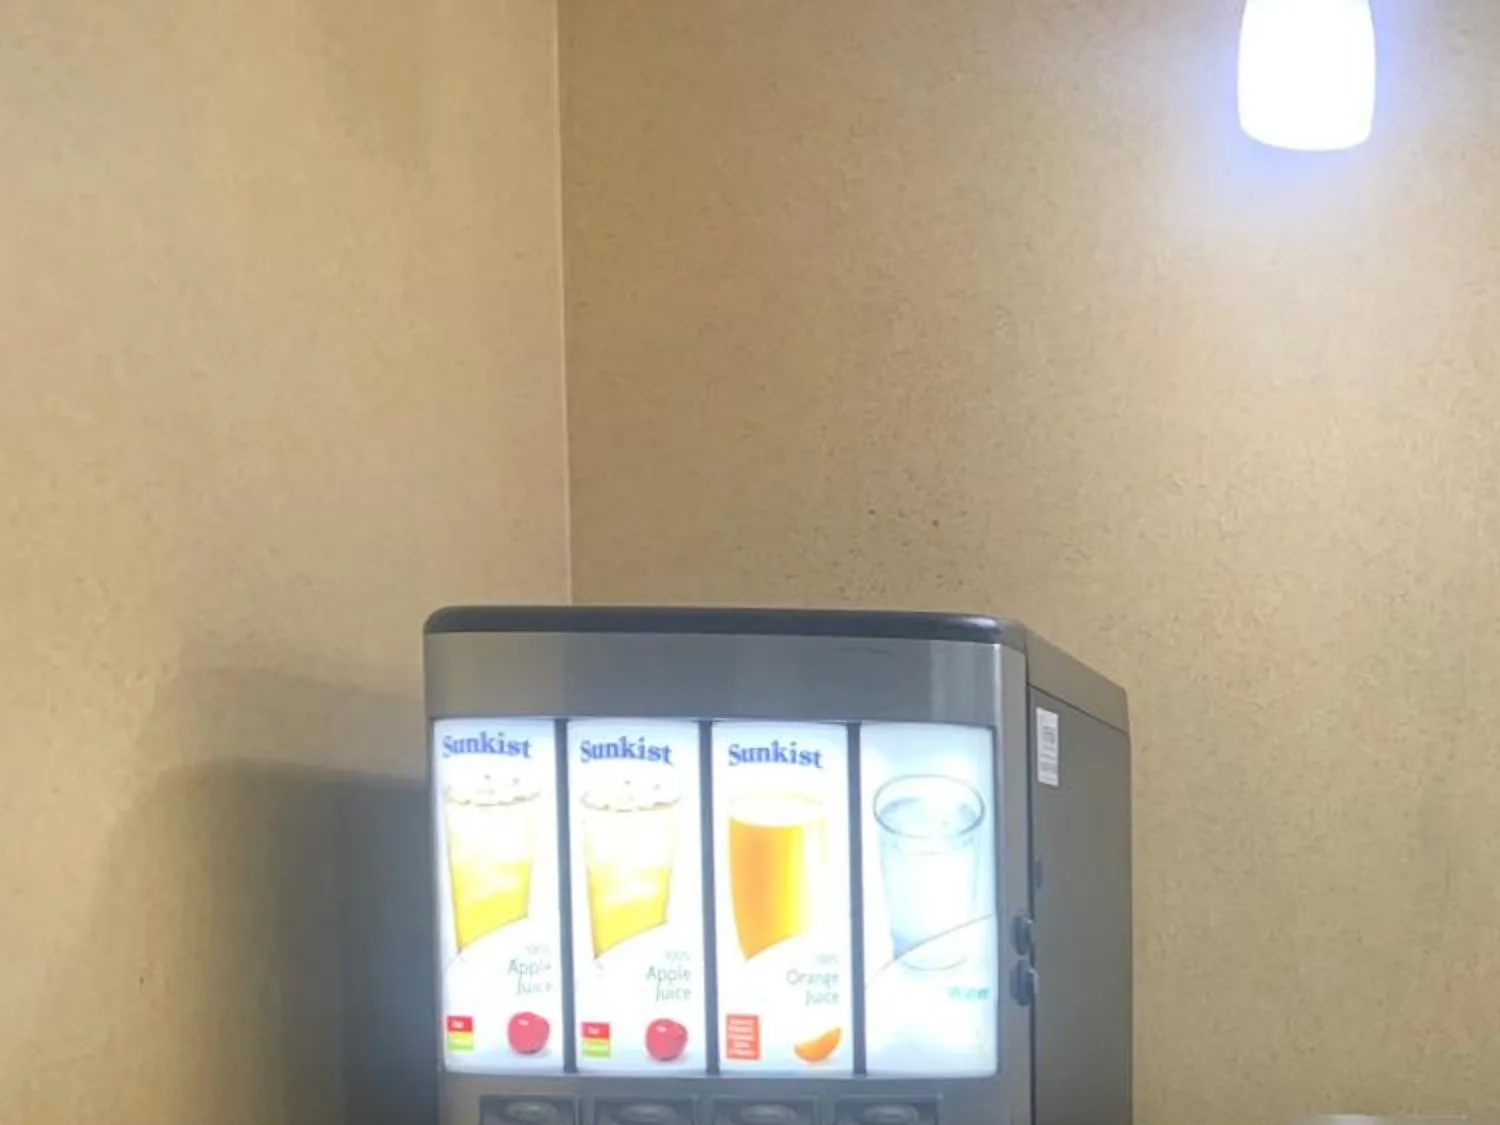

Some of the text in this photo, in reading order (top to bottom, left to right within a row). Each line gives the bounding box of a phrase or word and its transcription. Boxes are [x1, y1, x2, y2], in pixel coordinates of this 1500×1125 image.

[442, 731, 533, 758] Sunkist
[580, 736, 674, 765] Sunkist
[728, 740, 824, 768] Sunkist
[647, 965, 692, 984] Apple
[786, 968, 839, 989] Orange
